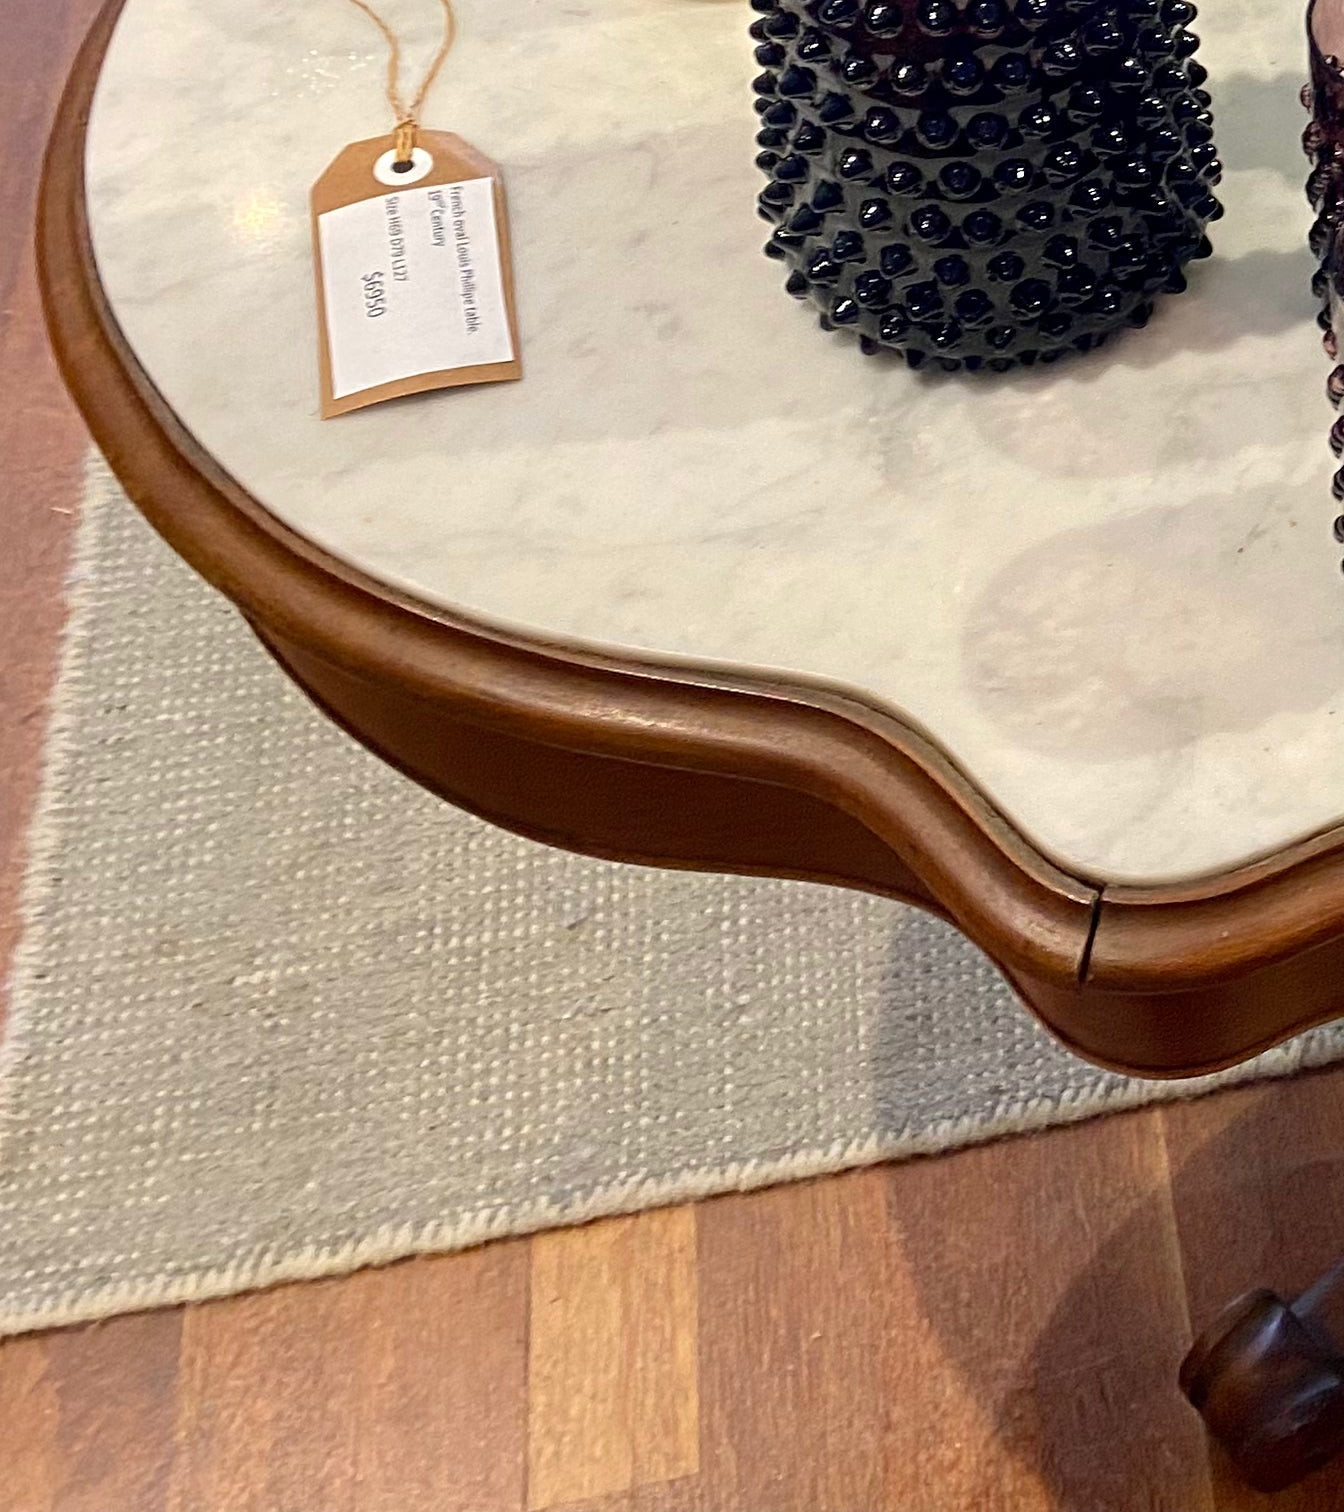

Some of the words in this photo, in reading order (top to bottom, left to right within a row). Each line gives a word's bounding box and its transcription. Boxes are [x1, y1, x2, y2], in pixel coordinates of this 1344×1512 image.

[385, 196, 399, 215] Size
[450, 186, 466, 218] French
[430, 209, 446, 247] Century
[453, 219, 470, 241] oval
[456, 241, 471, 268] Louis
[361, 271, 387, 318] $6950
